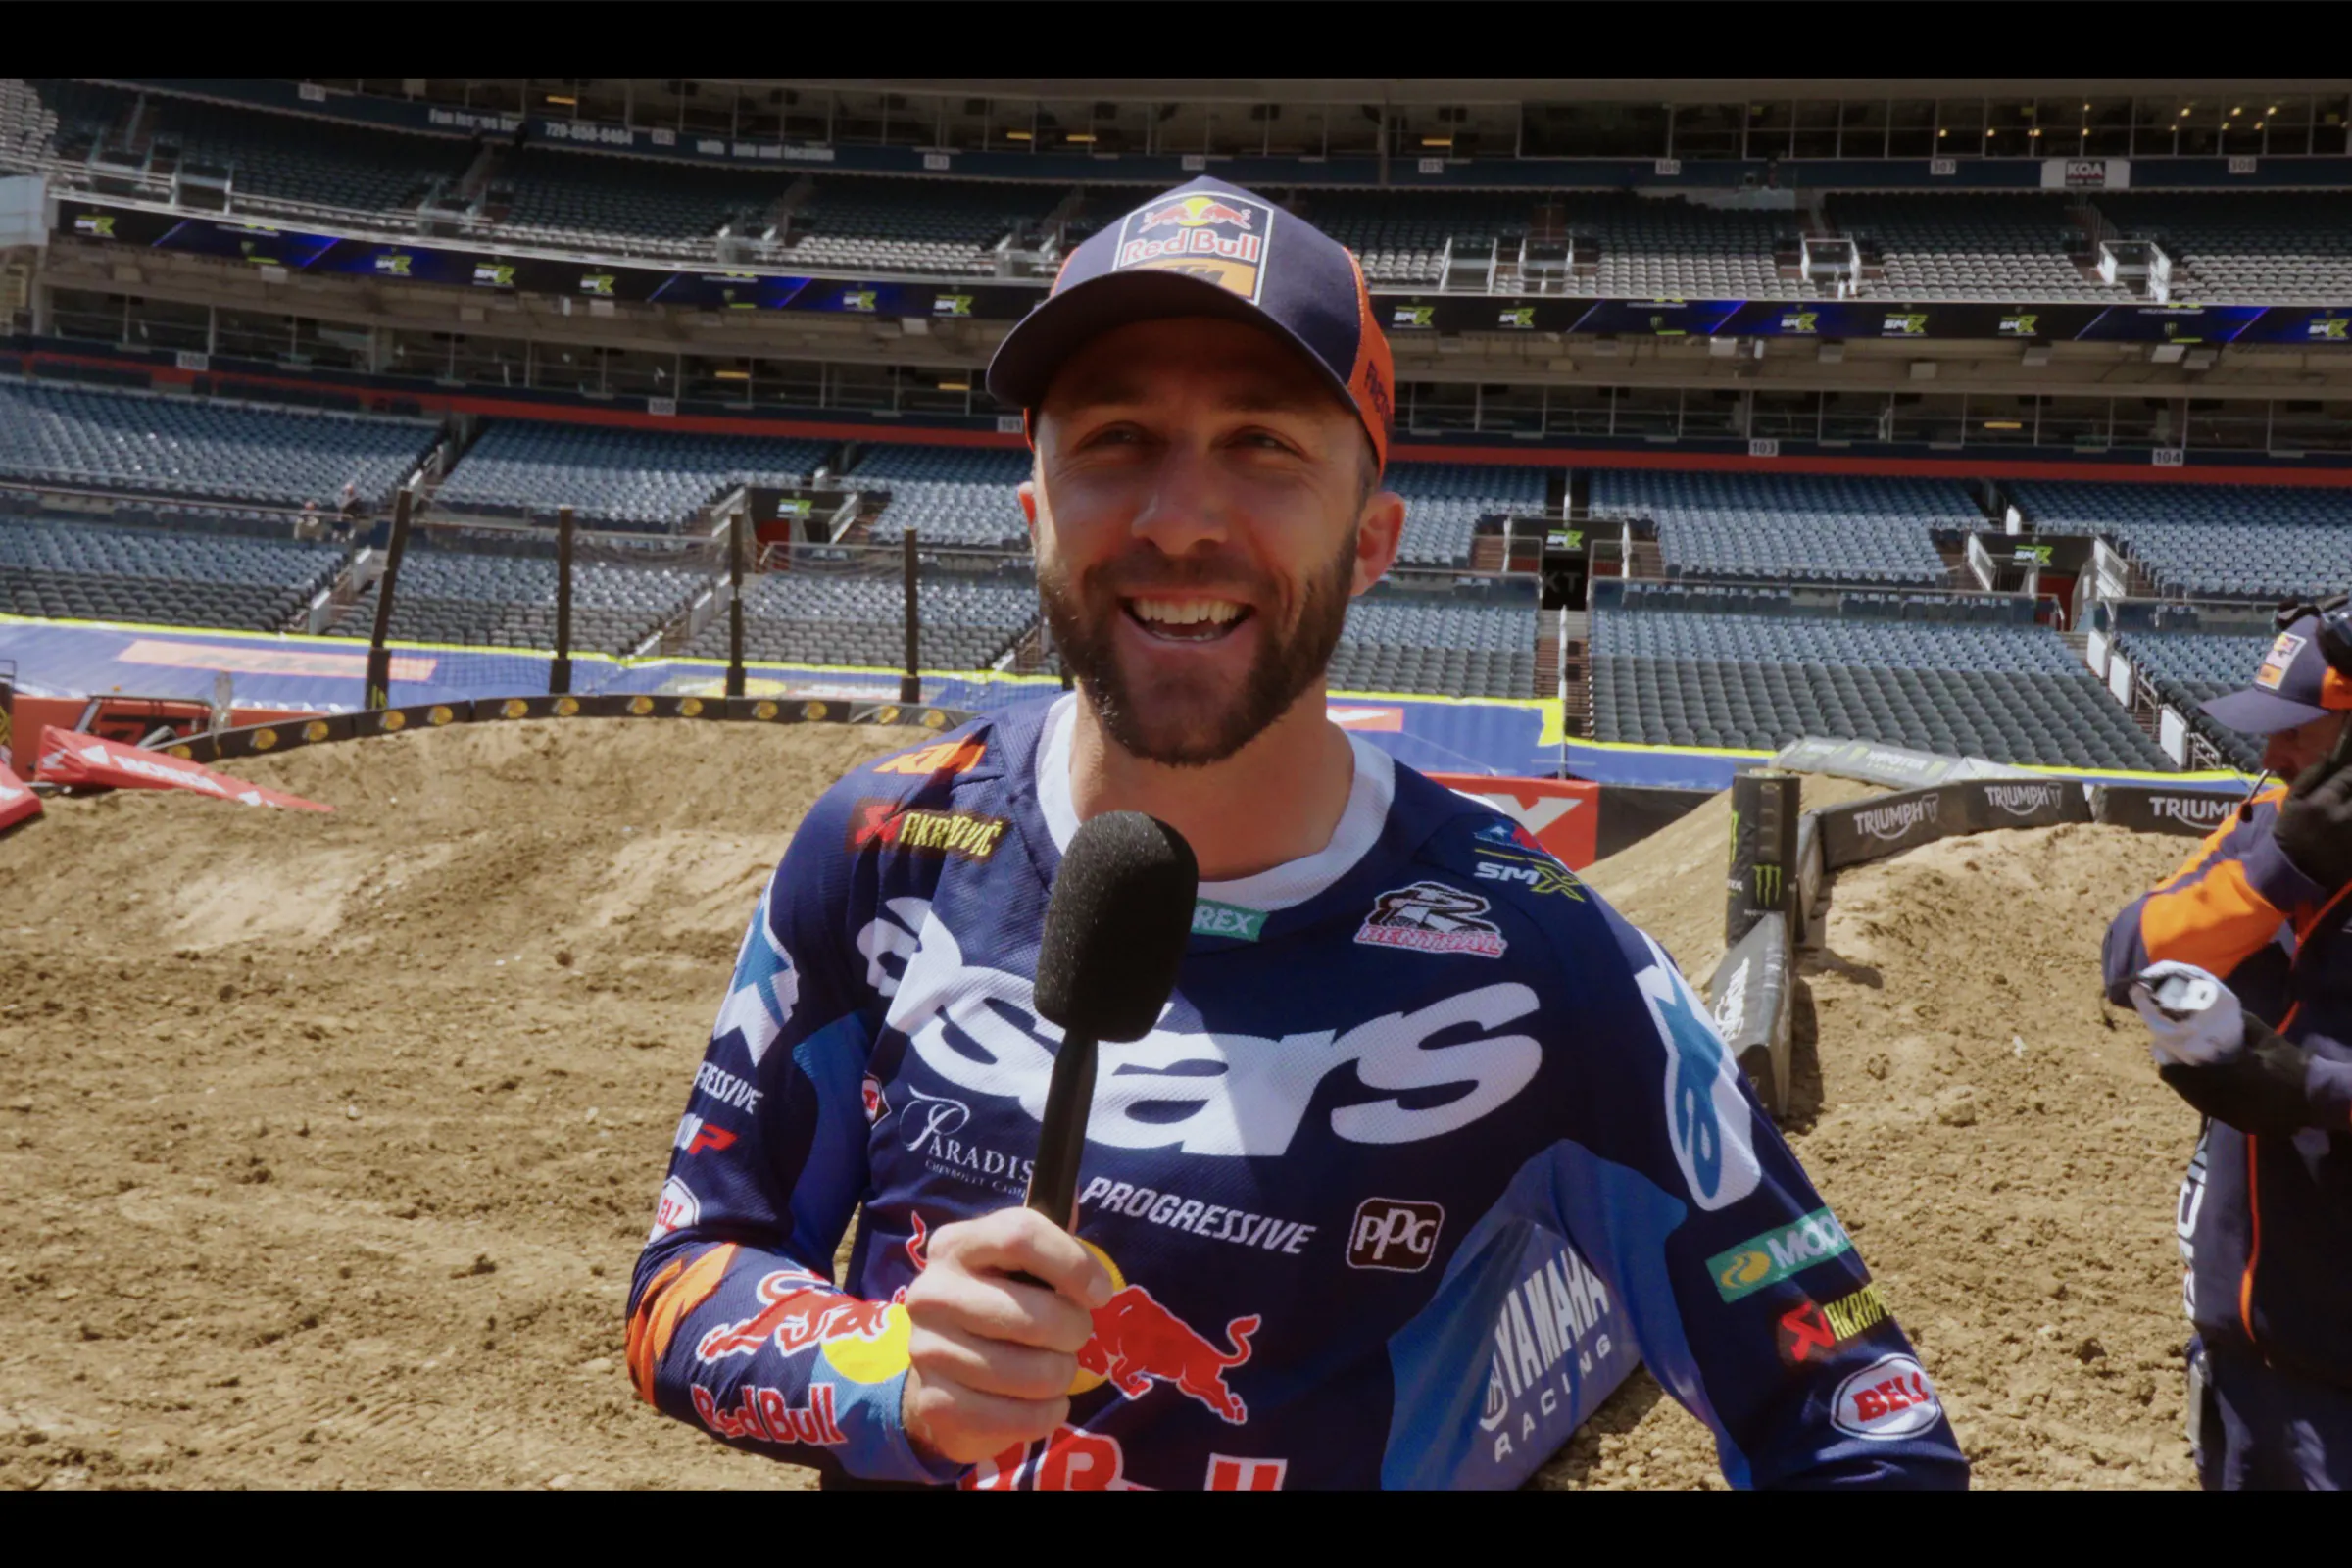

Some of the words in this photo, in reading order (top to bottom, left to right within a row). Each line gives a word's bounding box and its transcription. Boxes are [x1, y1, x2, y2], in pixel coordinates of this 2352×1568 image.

[2067, 161, 2105, 177] KOA
[1121, 228, 1189, 266] Red
[1189, 229, 1261, 263] Bull
[1853, 799, 1925, 837] TRIUMPH
[1984, 784, 2050, 812] TRIUMPH
[2149, 796, 2242, 821] TRIUM
[1473, 861, 1586, 902] SMX
[1193, 906, 1254, 934] REX
[899, 1083, 1037, 1184] PARADIS
[1079, 1176, 1317, 1255] PROGRESSIVE
[1353, 1208, 1437, 1260] PPG
[1494, 1246, 1610, 1398] YAMAHA
[691, 1383, 769, 1440] Red
[757, 1382, 848, 1445] Bull
[1494, 1333, 1612, 1463] RACING
